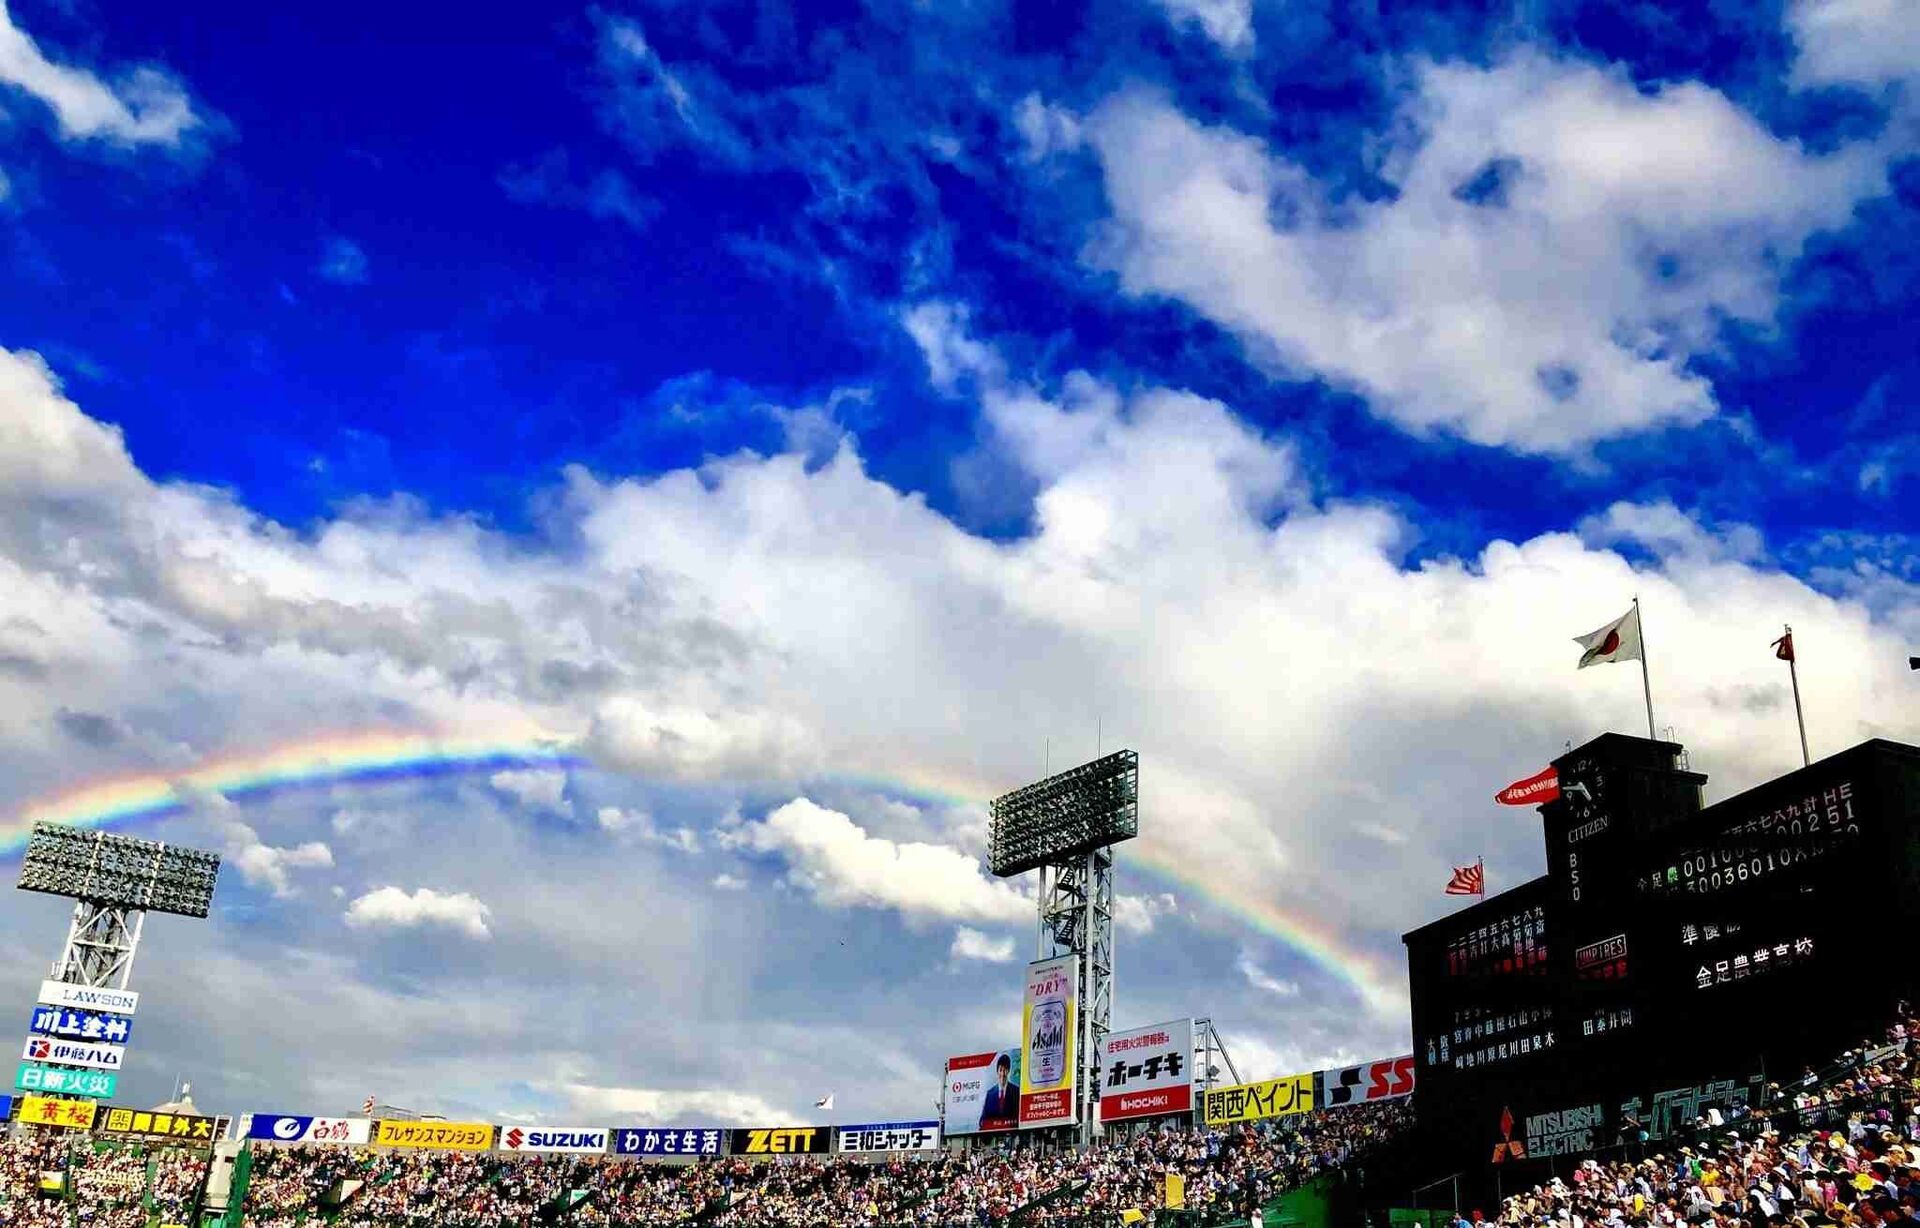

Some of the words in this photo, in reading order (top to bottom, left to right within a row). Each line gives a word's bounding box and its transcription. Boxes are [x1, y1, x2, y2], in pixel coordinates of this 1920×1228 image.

[1567, 815, 1609, 844] CITIZEN
[1569, 853, 1577, 868] B
[1571, 870, 1580, 884] S
[63, 989, 134, 1008] LAWSON
[36, 1011, 127, 1040] 川上塗料
[1032, 1024, 1063, 1051] Asahi
[54, 1045, 118, 1065] 伊藤ハム
[1042, 1057, 1051, 1067] 生
[1107, 1052, 1183, 1087] ホーチキ
[22, 1071, 111, 1096] 日新火災
[1128, 1096, 1168, 1109] HOCHIKI
[1207, 1080, 1312, 1121] 関西ペイント
[40, 1101, 94, 1127] 黄桜
[1526, 1103, 1602, 1137] MITSUBISHI
[314, 1120, 349, 1140] 白鶴
[528, 1132, 604, 1148] SUZUKI
[746, 1128, 816, 1153] ZETT
[845, 1129, 932, 1151] 三和シャッター
[625, 1131, 719, 1154] わかさ生活
[1528, 1128, 1594, 1158] ELECTRIC
